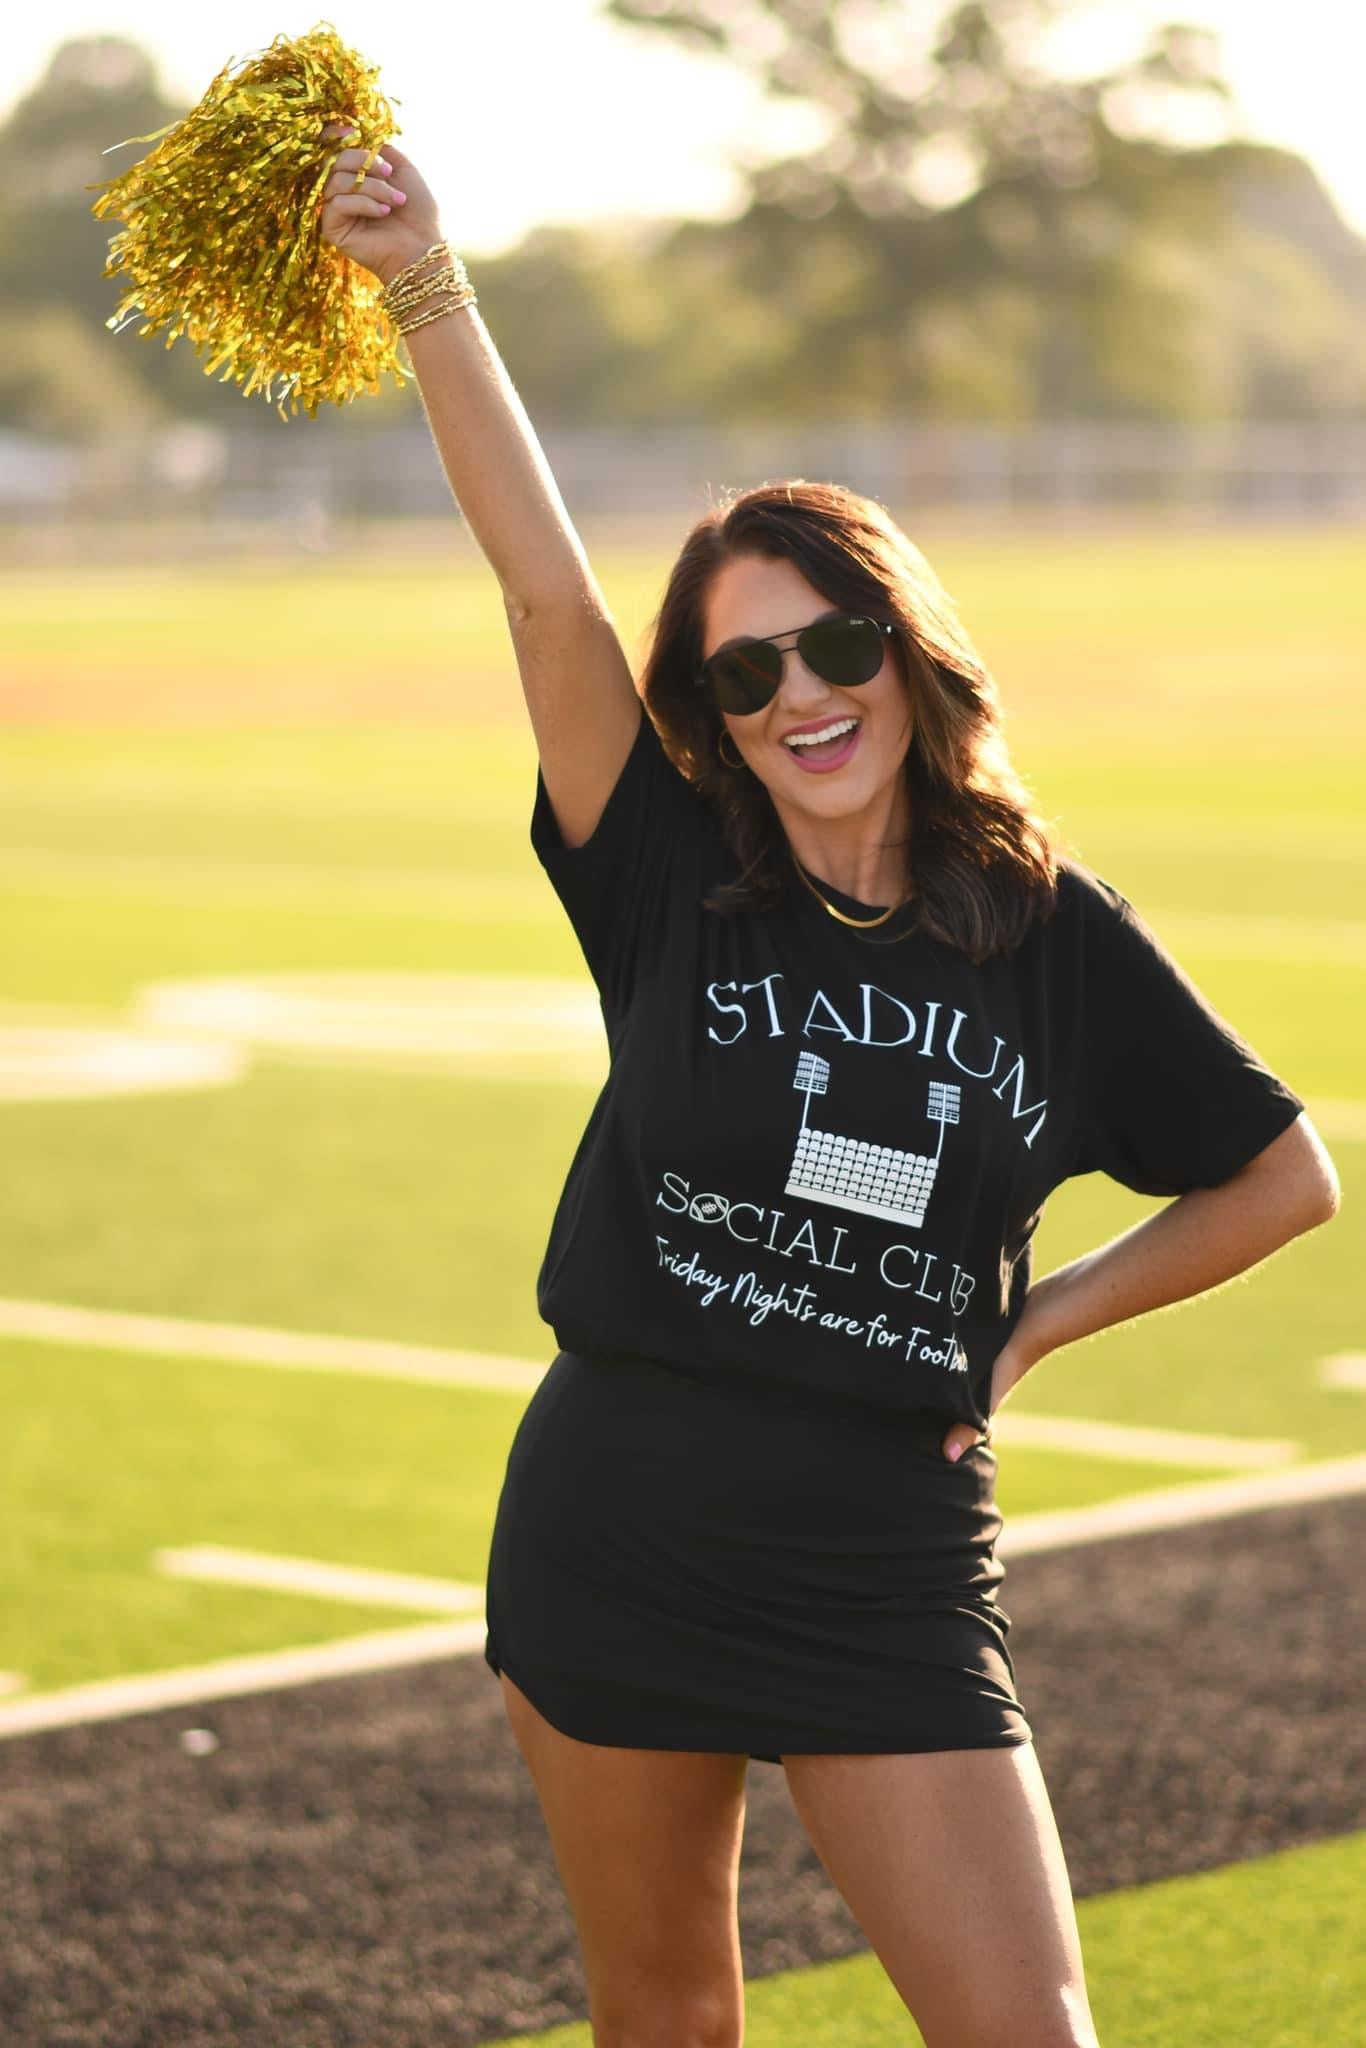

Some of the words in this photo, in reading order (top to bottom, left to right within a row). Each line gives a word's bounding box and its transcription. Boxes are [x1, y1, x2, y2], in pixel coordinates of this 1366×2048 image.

[707, 973, 1047, 1150] STADIUM
[656, 1172, 857, 1274] SOCIAL
[656, 1235, 730, 1307] Friday
[730, 1271, 817, 1326] Nights
[819, 1312, 865, 1336] are
[865, 1313, 903, 1348] for
